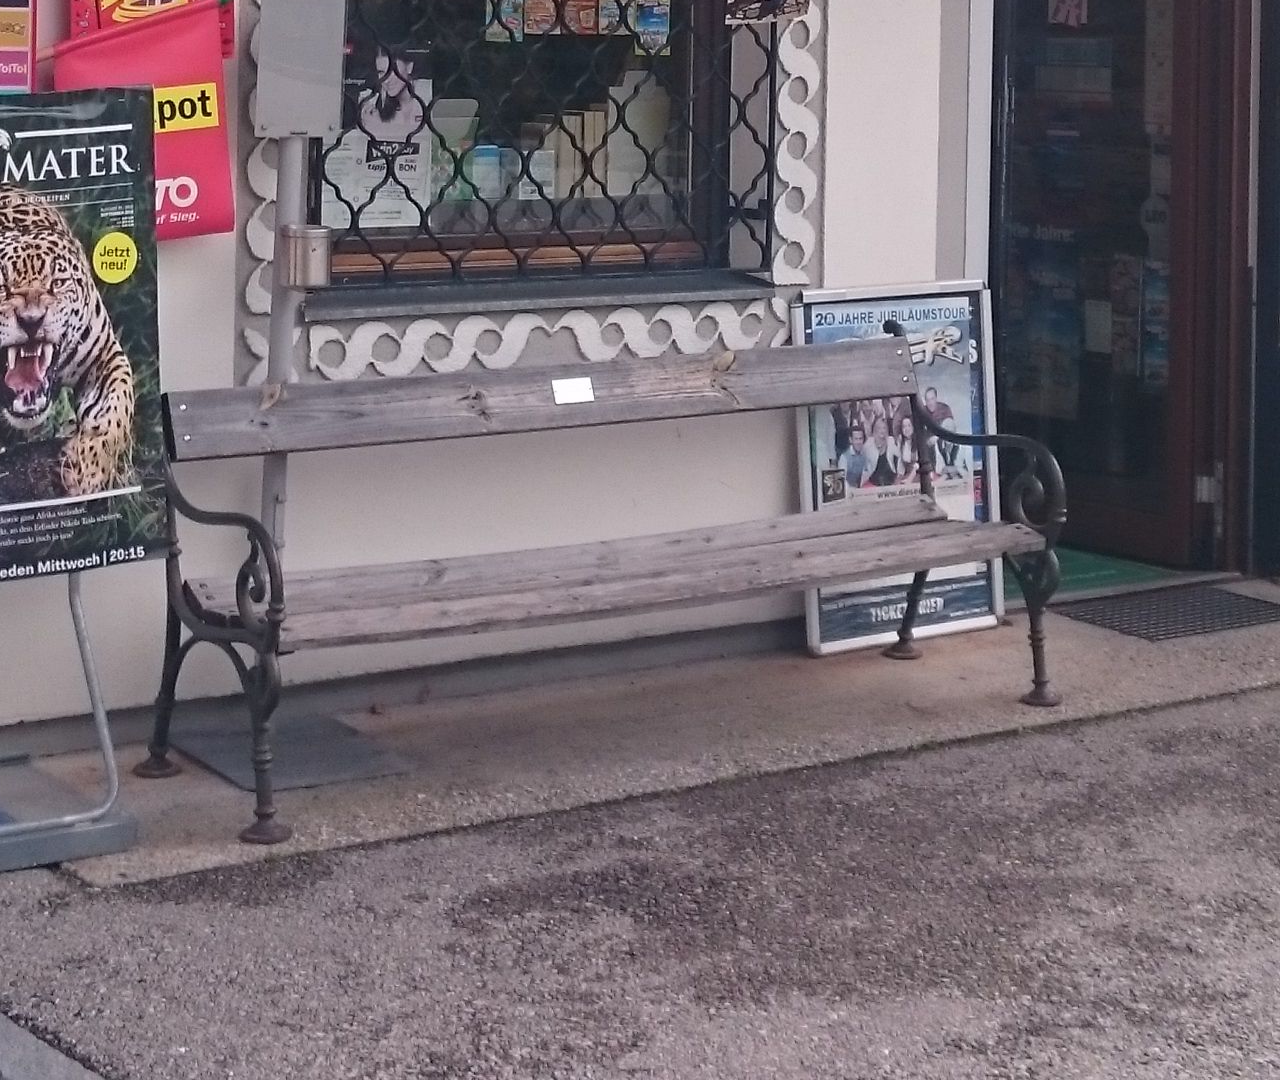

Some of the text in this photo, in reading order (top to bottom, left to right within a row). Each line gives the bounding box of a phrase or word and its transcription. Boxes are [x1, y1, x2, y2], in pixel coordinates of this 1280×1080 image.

[155, 89, 212, 129] pot
[1, 144, 136, 184] MATER
[367, 162, 387, 171] tipp
[398, 163, 417, 172] BON
[99, 246, 131, 258] Jetzt
[100, 259, 128, 270] neu!
[815, 306, 966, 327] 20 JAHRE JUBILÄUMSTOUR
[877, 487, 920, 499] www.diese
[38, 552, 101, 574] Mittwoch
[109, 545, 145, 562] 20:15
[871, 602, 909, 622] TICKET
